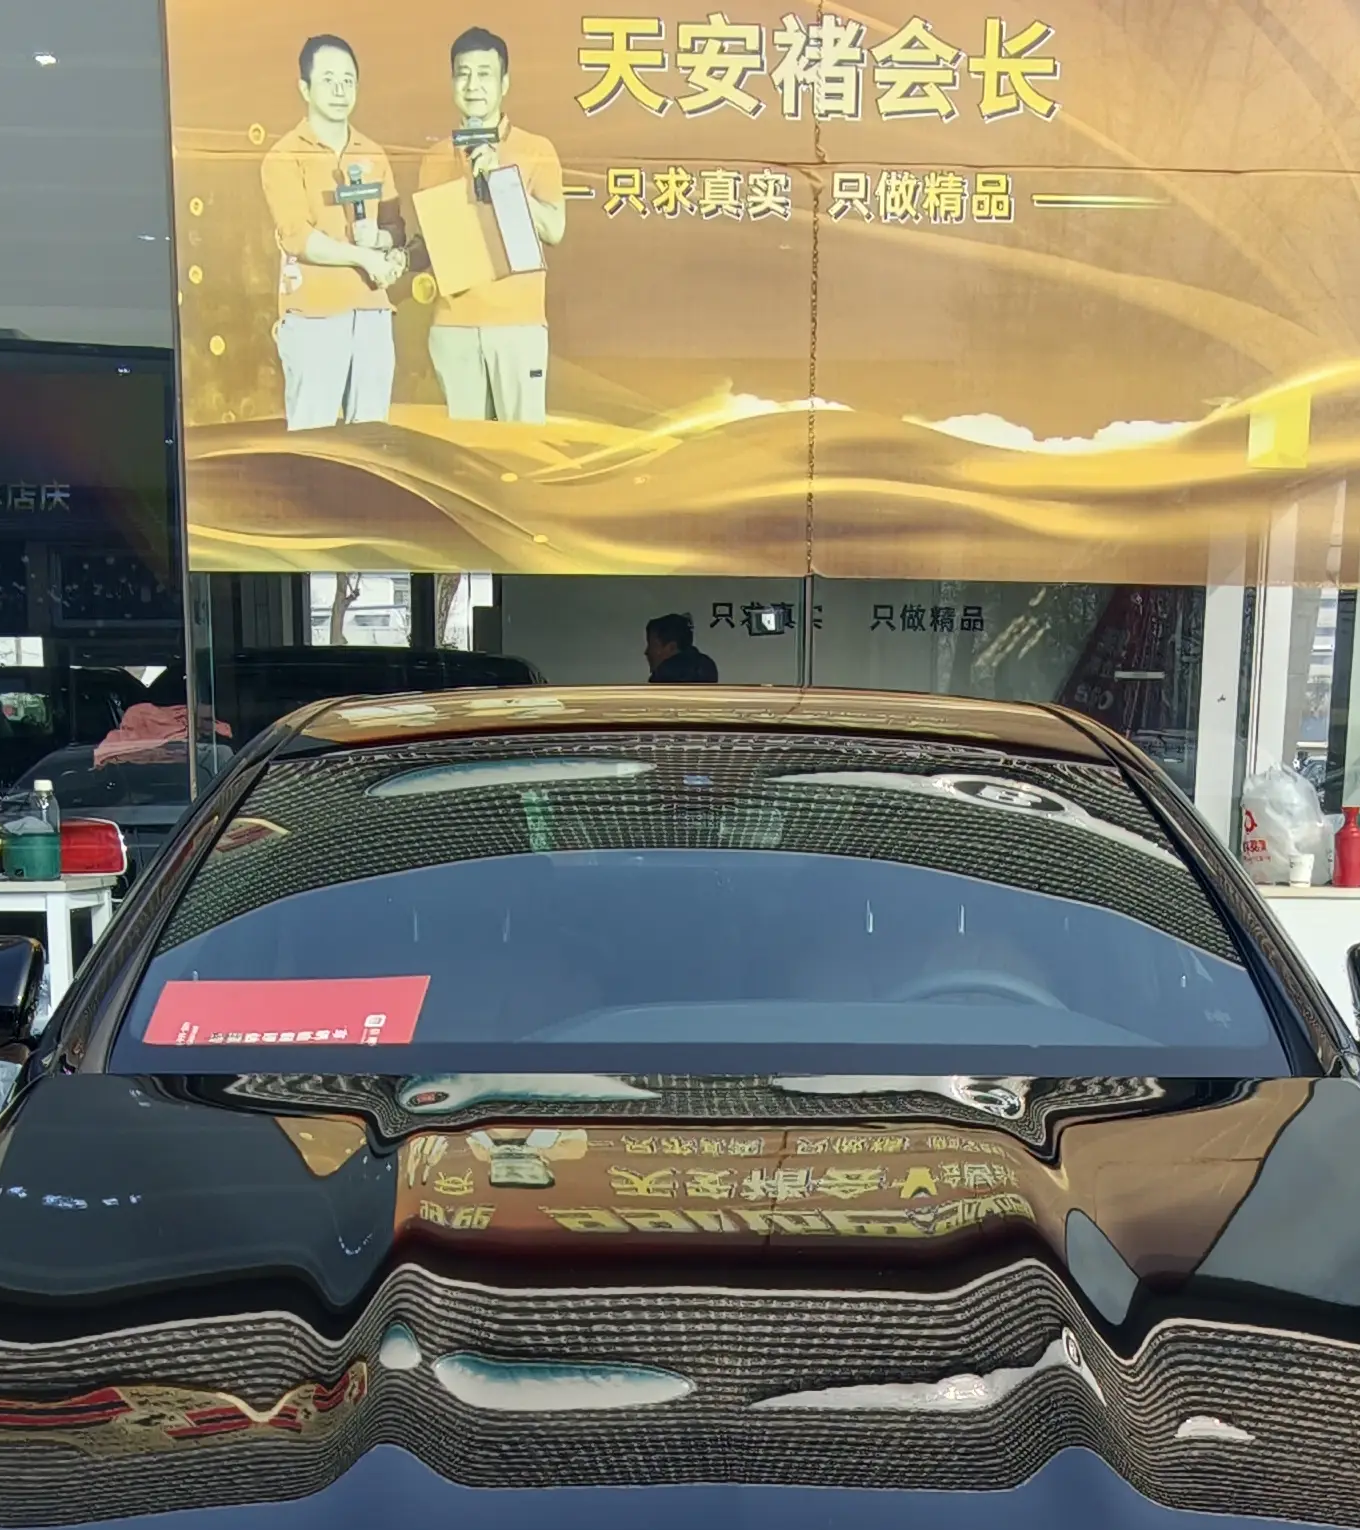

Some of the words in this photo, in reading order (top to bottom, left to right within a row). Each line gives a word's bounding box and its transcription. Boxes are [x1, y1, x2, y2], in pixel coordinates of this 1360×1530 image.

[574, 12, 1062, 123] 天安褚会长
[602, 166, 792, 222] 只求真实
[827, 169, 1016, 224] 只做精品
[869, 602, 985, 632] 只做精品
